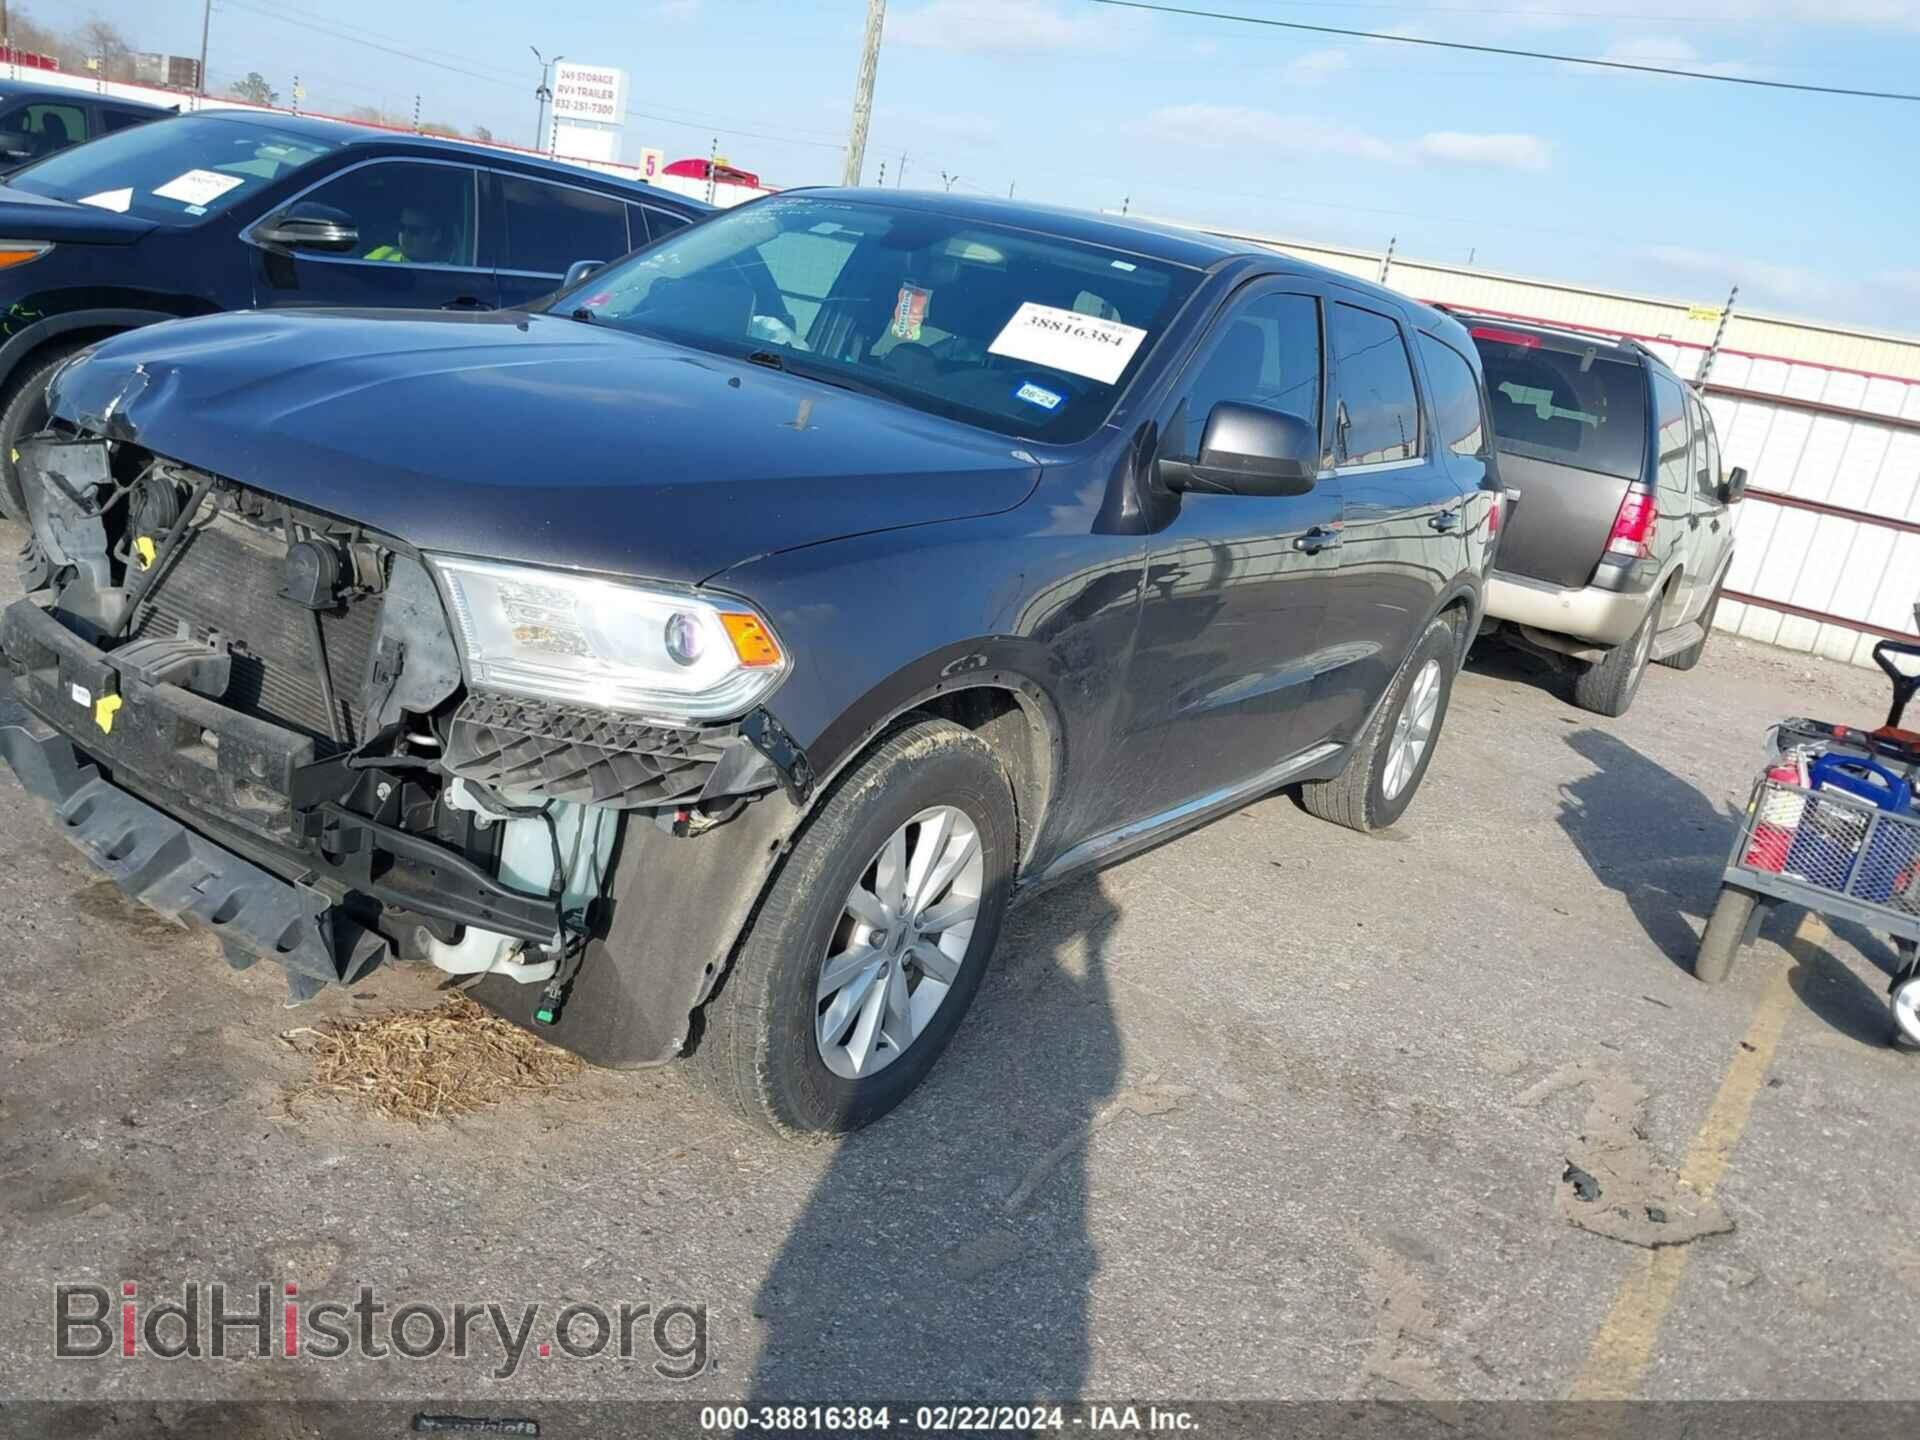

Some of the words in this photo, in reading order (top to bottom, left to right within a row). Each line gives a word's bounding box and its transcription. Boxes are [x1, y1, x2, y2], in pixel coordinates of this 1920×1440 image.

[576, 71, 614, 85] STORAGE
[576, 86, 614, 99] TRAILER
[645, 155, 656, 177] 5
[1024, 315, 1123, 348] 38816384
